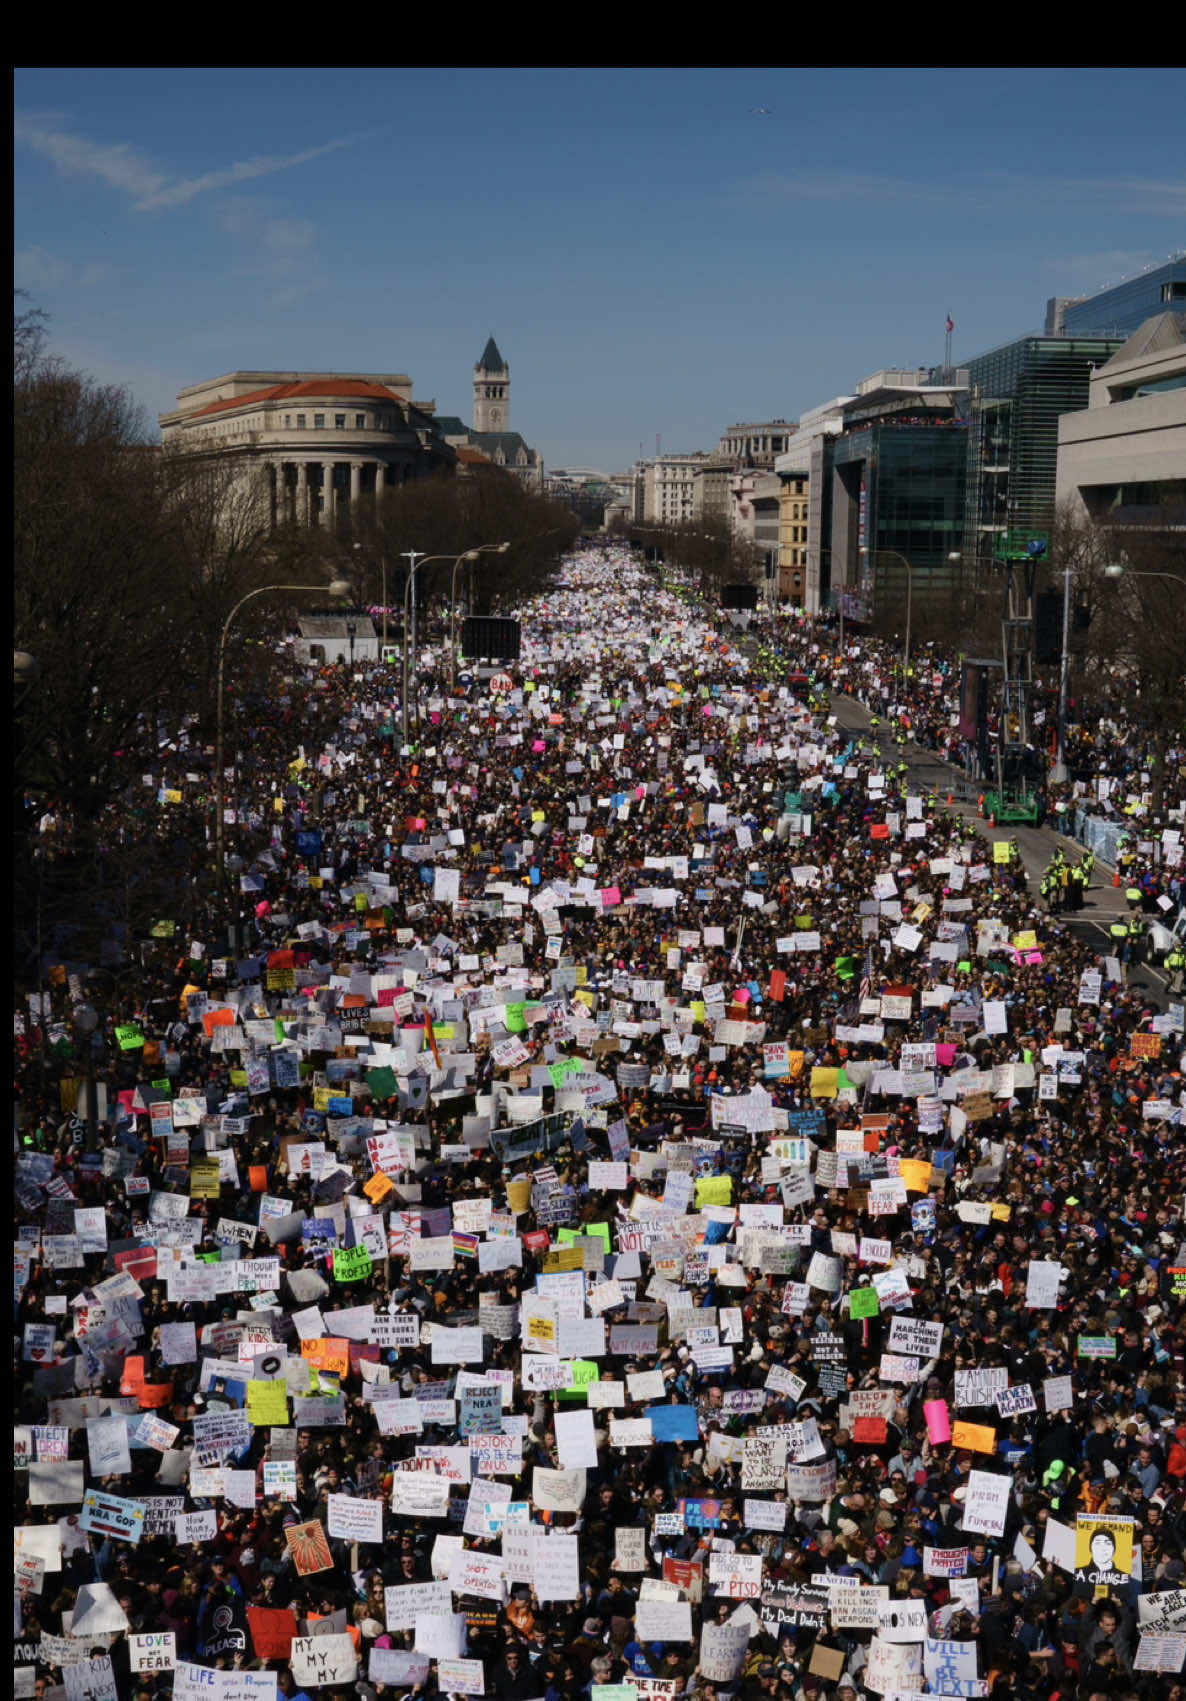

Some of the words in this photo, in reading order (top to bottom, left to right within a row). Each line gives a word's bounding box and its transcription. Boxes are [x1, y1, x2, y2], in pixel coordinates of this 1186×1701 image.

[222, 1225, 253, 1239] WHEN
[620, 1234, 645, 1251] NOT
[334, 1246, 366, 1262] PEOPLE
[894, 1325, 939, 1337] MARCHING
[376, 1337, 390, 1345] NOT
[892, 1332, 908, 1341] FOR
[914, 1335, 938, 1346] THEIR
[906, 1344, 931, 1354] LIVES
[466, 1387, 498, 1397] REJECT
[997, 1385, 1030, 1401] NEVER
[1000, 1396, 1034, 1415] AGAIN
[471, 1436, 516, 1449] HISTORY
[471, 1450, 490, 1460] HAS
[745, 1449, 772, 1457] WANT
[479, 1461, 493, 1472] ON
[494, 1461, 508, 1472] US
[745, 1466, 785, 1479] SCARED
[88, 1508, 110, 1521] NRA
[115, 1514, 136, 1527] GOP
[1077, 1521, 1093, 1531] WE
[1095, 1521, 1132, 1533] DEMAND
[1088, 1571, 1129, 1585] CHANGE
[729, 1580, 760, 1597] PTSD
[763, 1579, 777, 1592] My
[838, 1588, 855, 1597] STOP
[1146, 1594, 1163, 1607] WE
[1163, 1591, 1183, 1606] ARE
[761, 1607, 776, 1622] My
[778, 1609, 796, 1624] Dad
[837, 1616, 873, 1624] WEAPONS
[136, 1634, 172, 1648] LOVE
[204, 1637, 245, 1656] PLEASE
[295, 1638, 313, 1653] MY
[927, 1640, 970, 1656] WILL
[139, 1657, 171, 1669] FEAR
[307, 1652, 329, 1668] MY
[940, 1656, 958, 1669] I
[190, 1667, 215, 1685] LIFE
[317, 1668, 338, 1683] MY
[936, 1668, 958, 1680] BE
